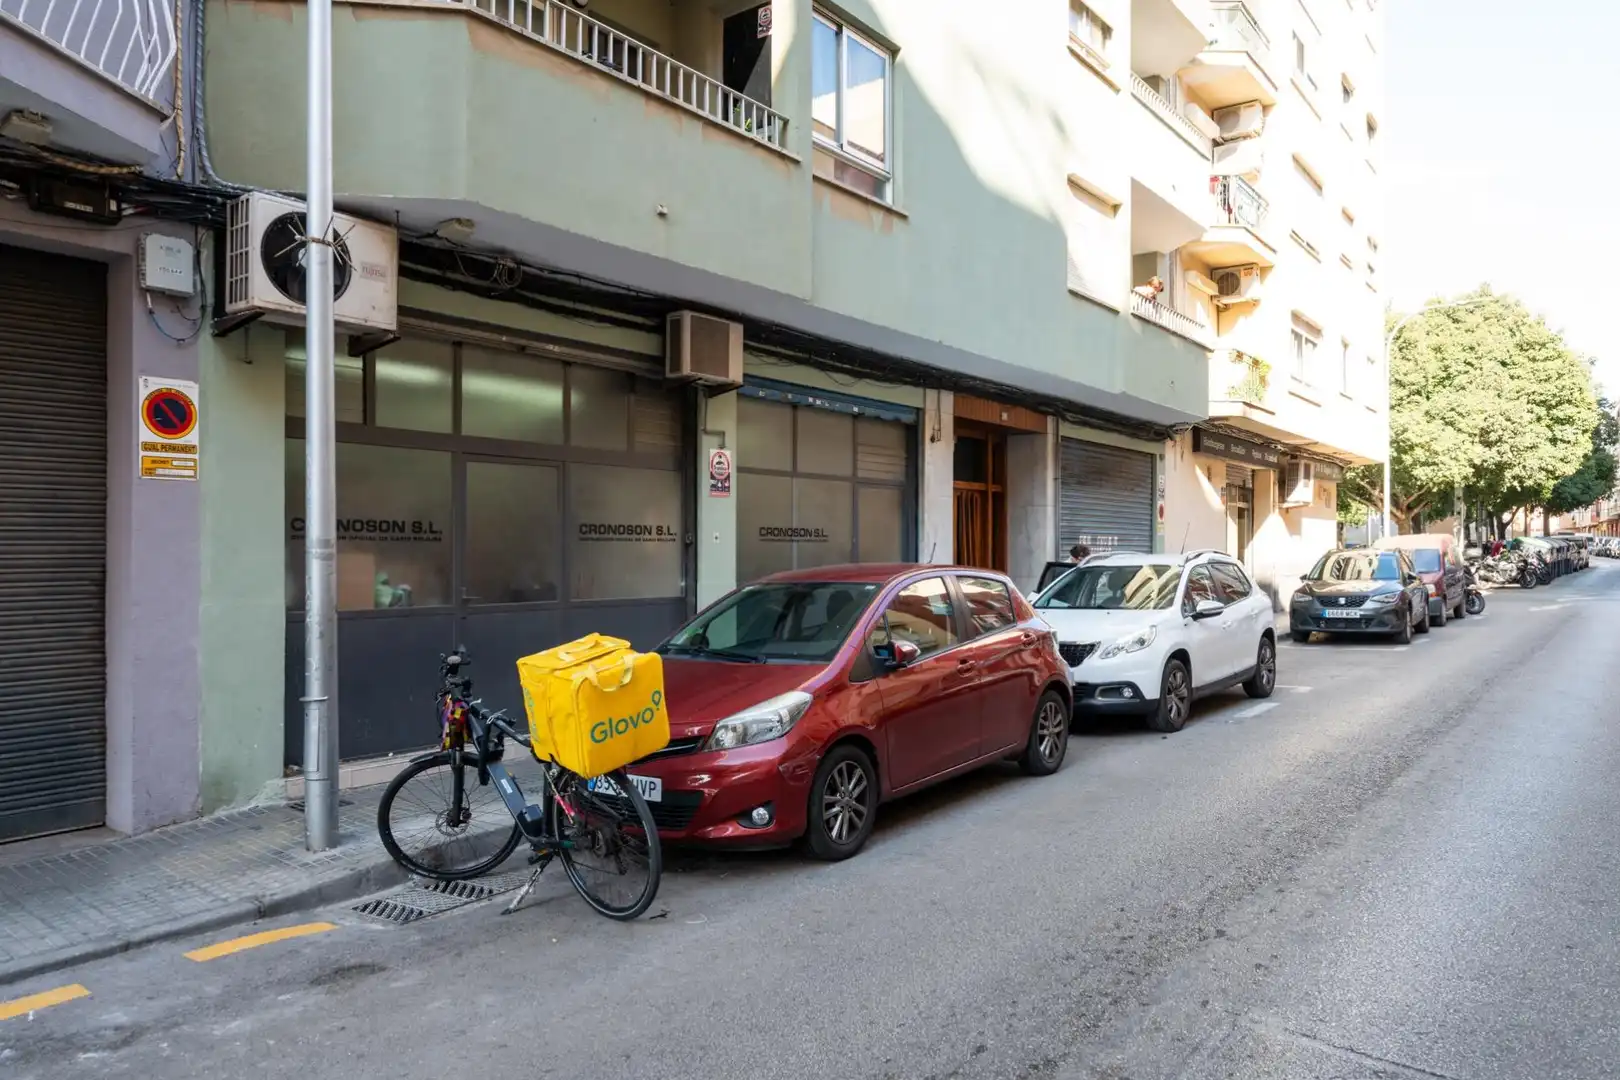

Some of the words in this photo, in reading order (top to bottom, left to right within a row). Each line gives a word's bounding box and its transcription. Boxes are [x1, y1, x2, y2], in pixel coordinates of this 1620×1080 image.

[290, 517, 405, 533] CNOSON
[411, 520, 443, 534] S.L.
[579, 523, 653, 536] CRONOSON
[655, 525, 677, 536] S.L.
[759, 527, 812, 537] CRONOSON
[590, 706, 655, 744] Glovo
